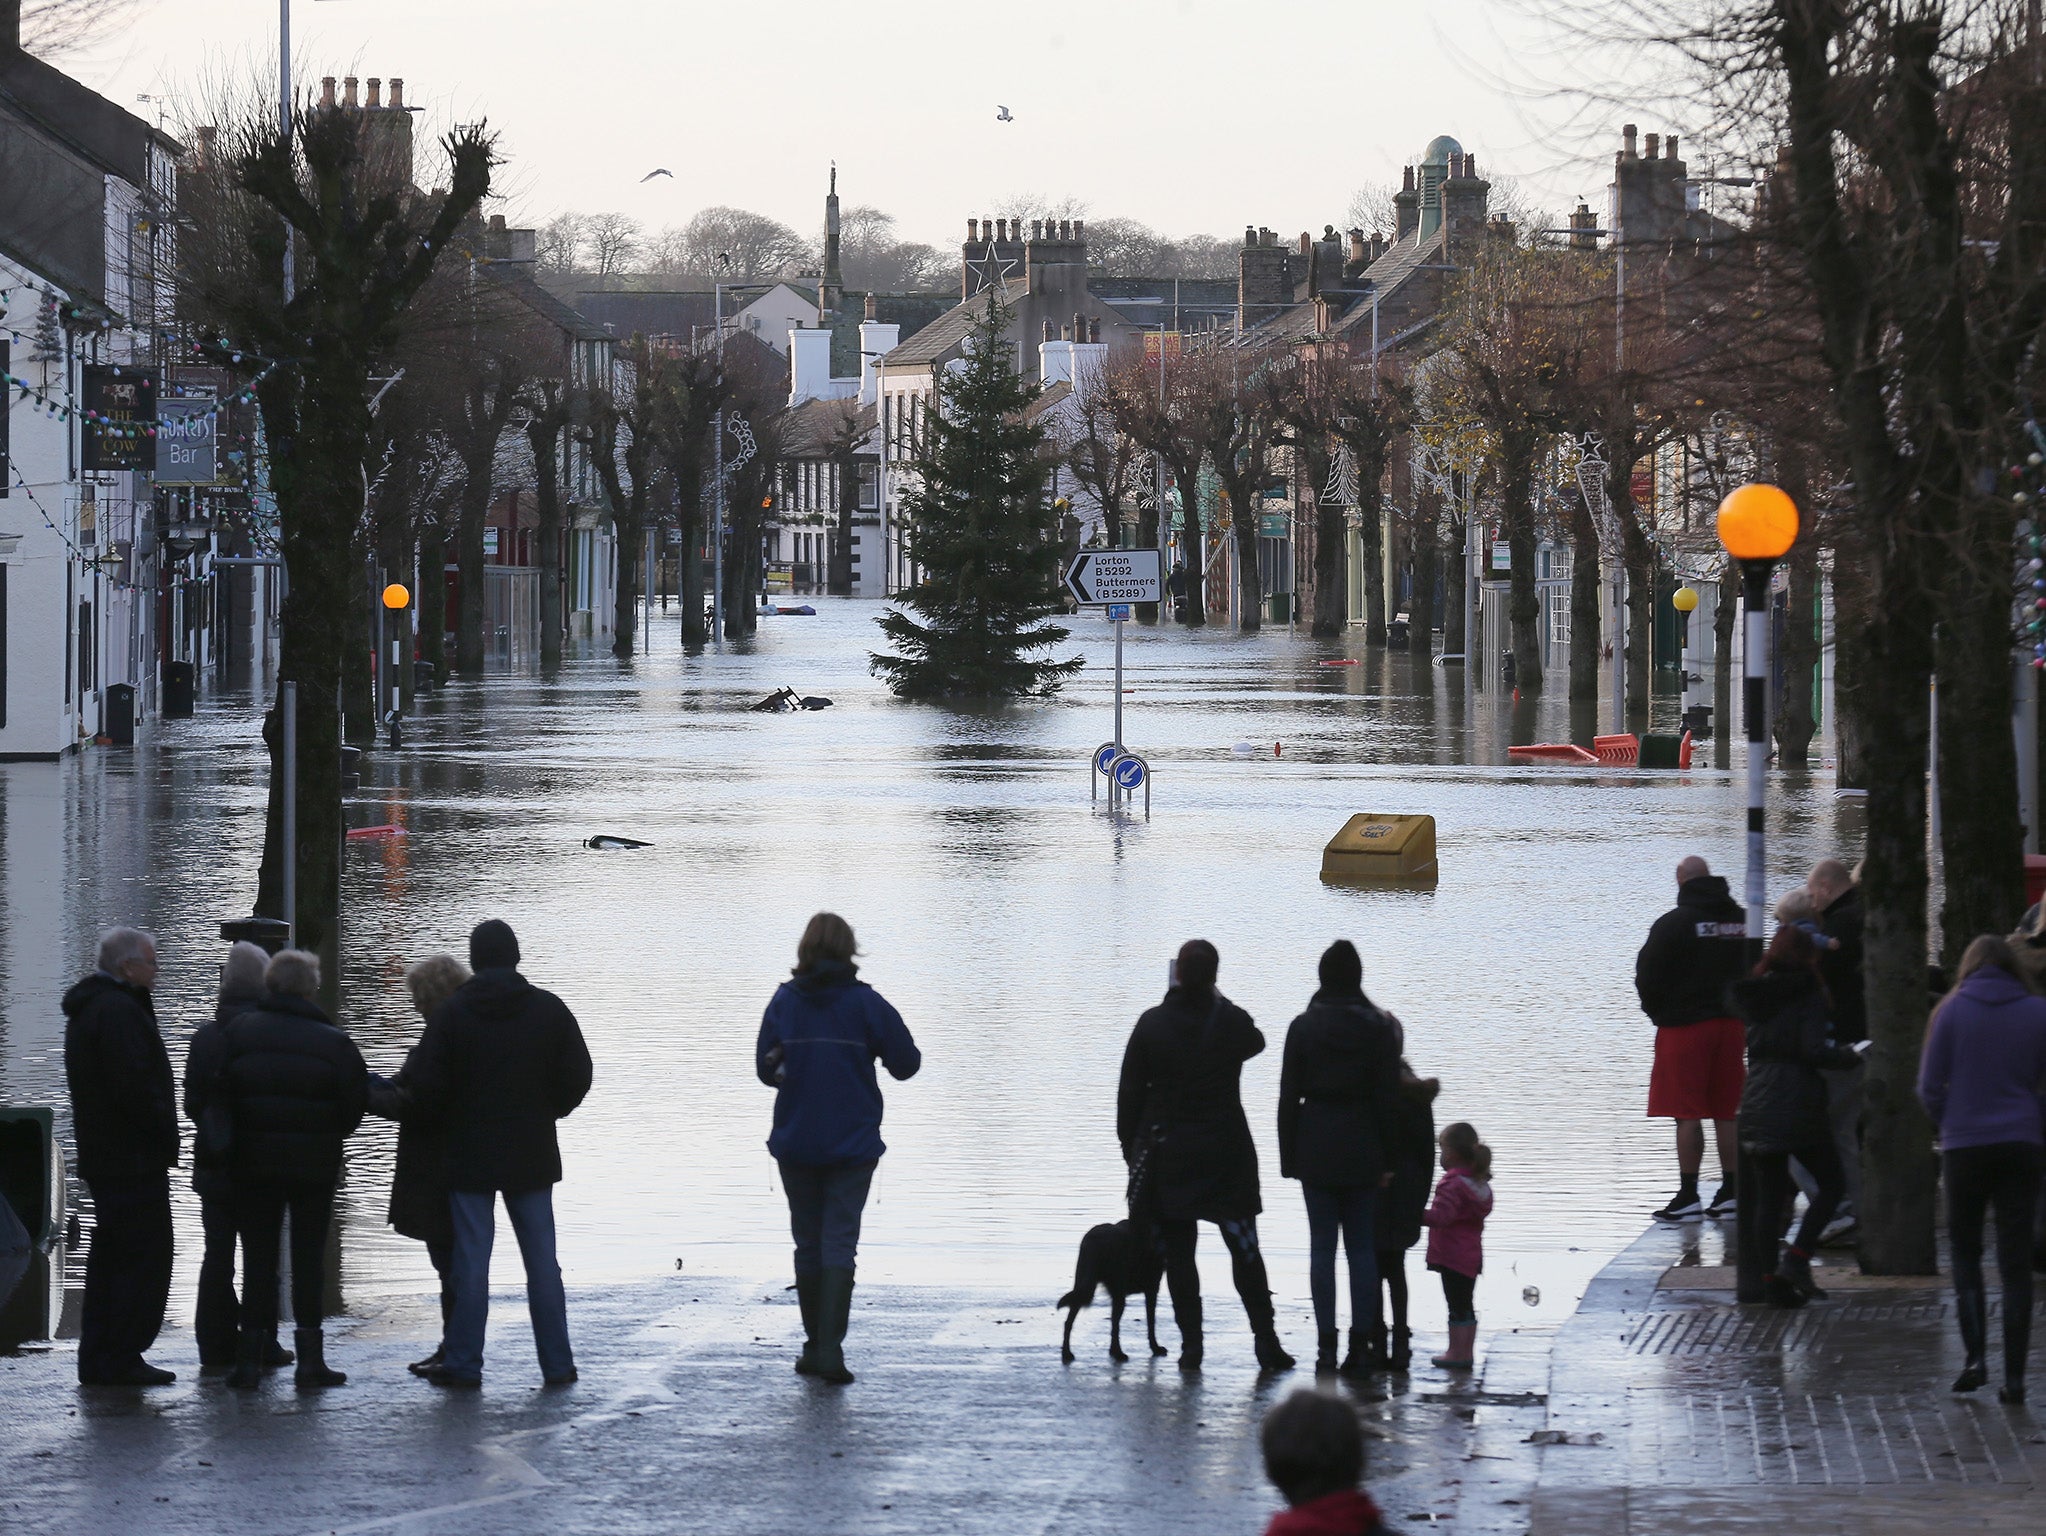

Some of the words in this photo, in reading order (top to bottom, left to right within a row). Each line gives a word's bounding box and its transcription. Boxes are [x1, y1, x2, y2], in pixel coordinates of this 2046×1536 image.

[1145, 335, 1180, 344] PRME
[104, 409, 134, 421] THE
[102, 439, 139, 452] COW
[170, 444, 197, 464] Bar
[1095, 556, 1129, 566] Lorton
[1095, 578, 1156, 587] Buttermere
